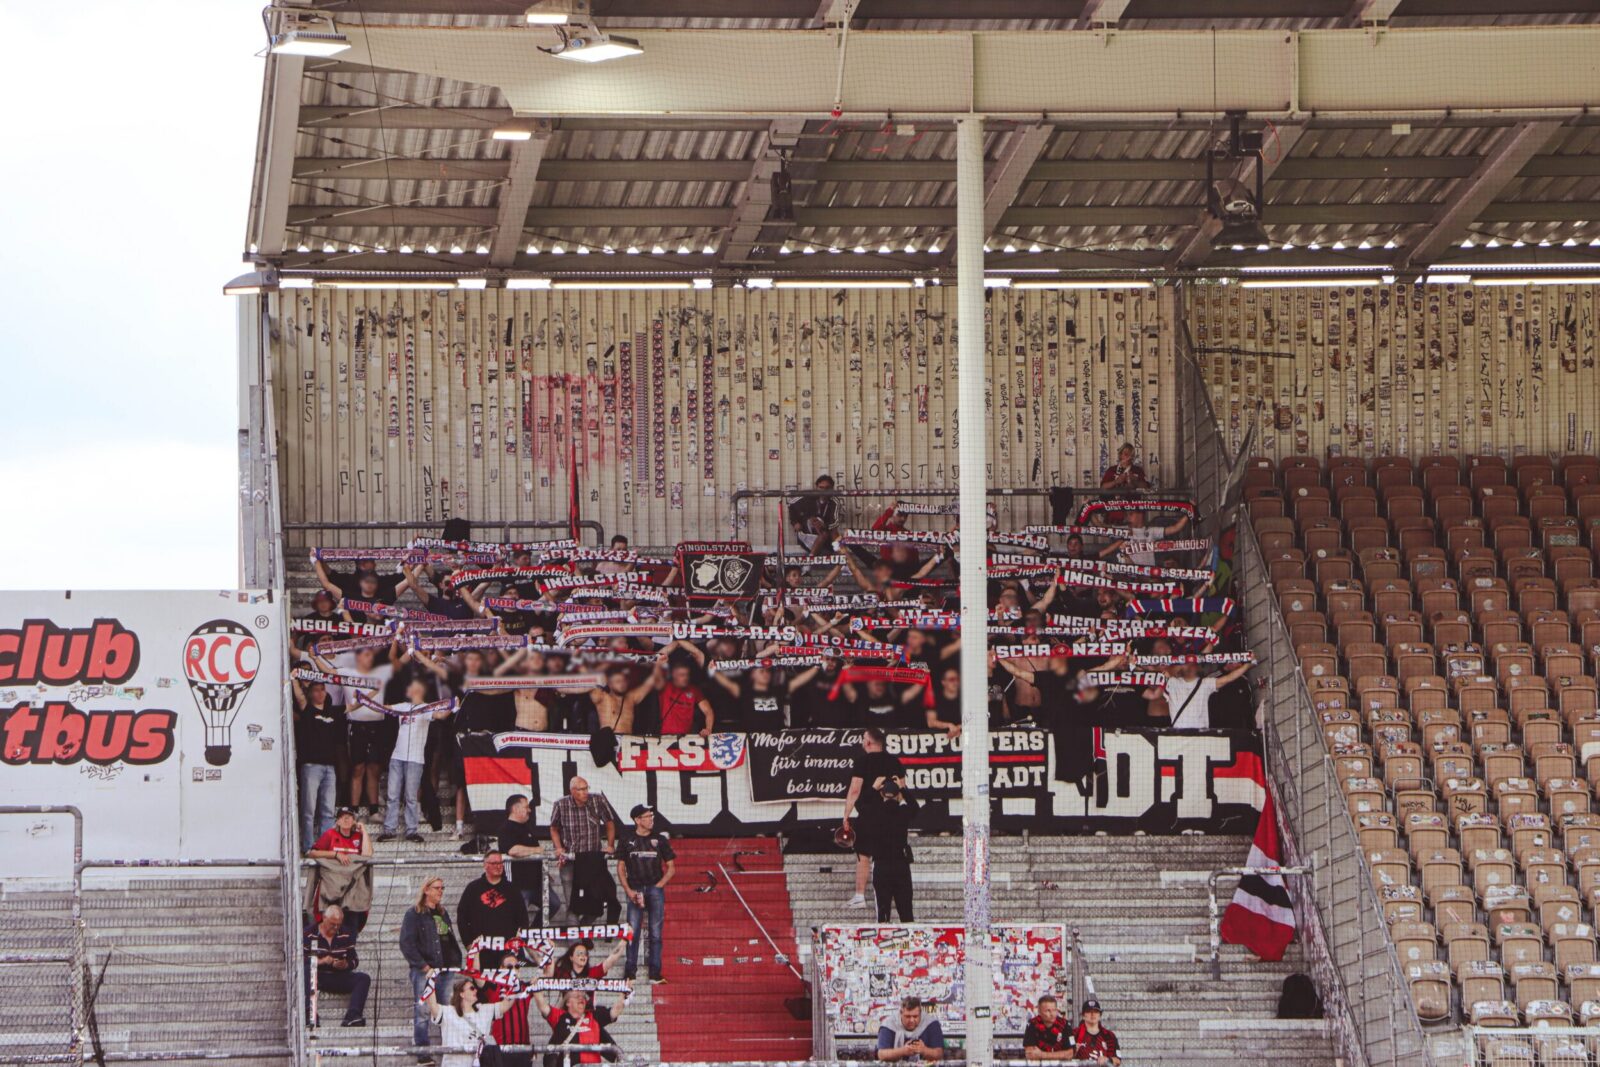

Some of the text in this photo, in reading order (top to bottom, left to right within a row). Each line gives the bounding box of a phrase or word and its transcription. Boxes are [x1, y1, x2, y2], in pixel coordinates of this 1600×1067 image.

[846, 528, 946, 544] NGOLSTA
[684, 543, 746, 552] INGOLSTADT
[991, 553, 1106, 572] INGOLSTADT
[452, 569, 509, 588] üdtribüne
[1064, 570, 1177, 593] INGOLSTADT
[348, 599, 372, 612] VOR
[489, 598, 515, 608] VOR
[673, 622, 796, 641] ULT RAS
[186, 635, 257, 683] RCC
[995, 643, 1126, 658] SCHA NZER
[1087, 670, 1165, 686] GOLSTAD
[801, 730, 836, 745] und
[886, 731, 1045, 755] SUPPOTERS
[620, 733, 706, 769] FKS
[770, 754, 855, 777] für immer
[786, 778, 847, 794] bei uns
[519, 924, 628, 942] NGOLSTADT
